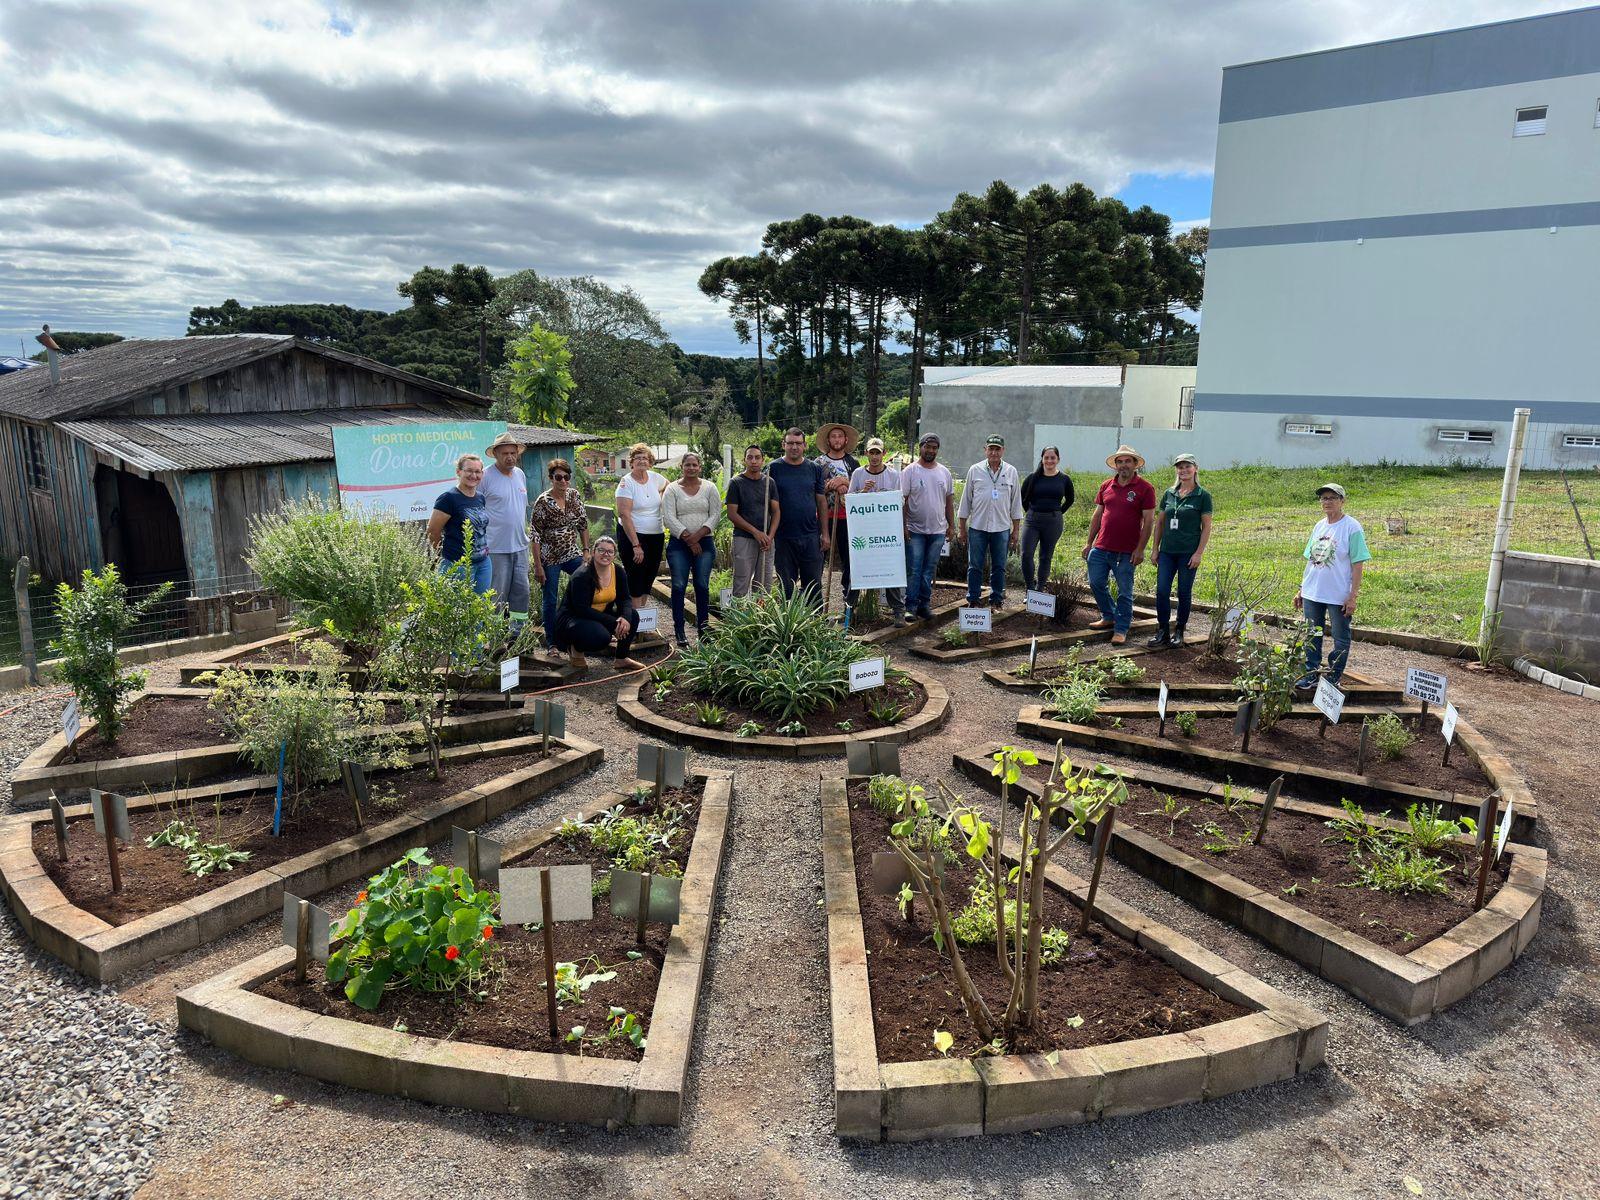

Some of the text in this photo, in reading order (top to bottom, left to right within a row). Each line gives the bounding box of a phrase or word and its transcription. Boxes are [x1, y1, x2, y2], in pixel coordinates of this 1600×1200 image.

[372, 430, 476, 445] HORTO MEDICINAL
[369, 442, 459, 474] Dona Oli
[849, 503, 900, 516] Aqui tem
[868, 535, 897, 544] SENAR
[1409, 688, 1419, 696] 21h
[1428, 693, 1435, 701] 23
[1436, 695, 1441, 703] h
